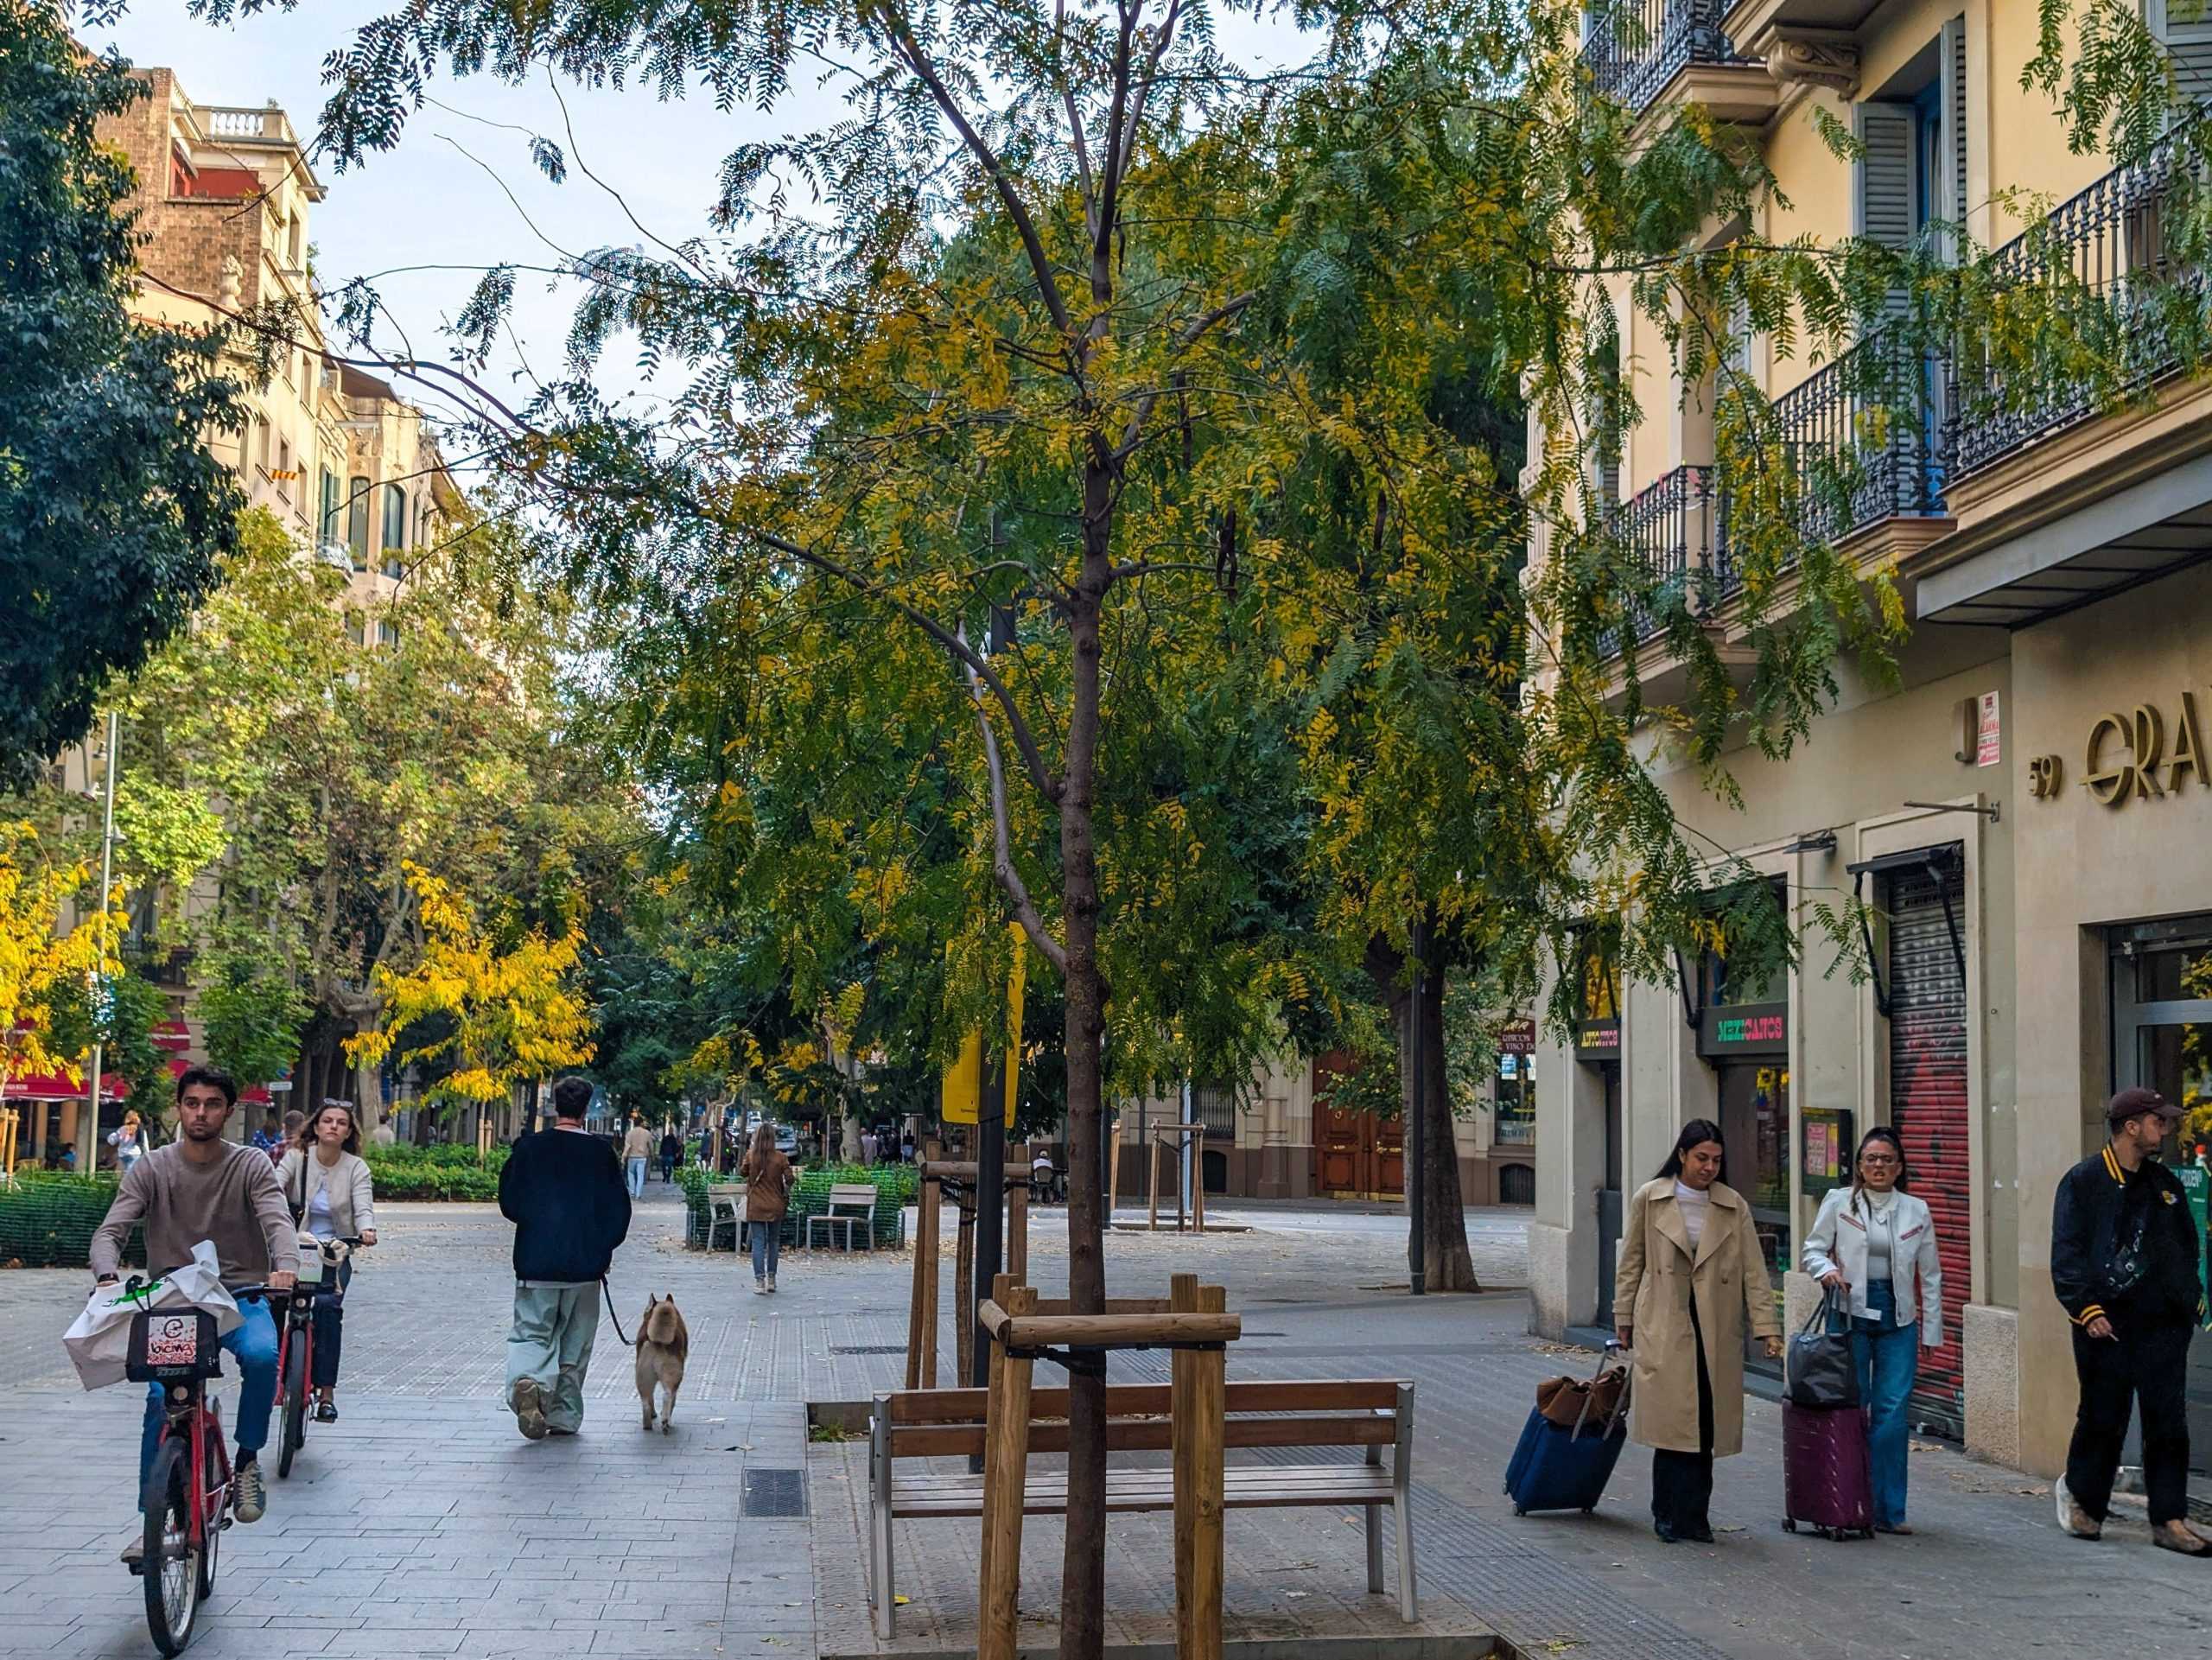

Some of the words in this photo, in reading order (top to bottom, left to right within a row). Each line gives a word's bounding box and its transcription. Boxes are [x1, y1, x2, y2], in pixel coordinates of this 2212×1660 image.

[2077, 691, 2212, 810] GRA
[2029, 754, 2062, 799] 59
[150, 1342, 194, 1357] bicing
